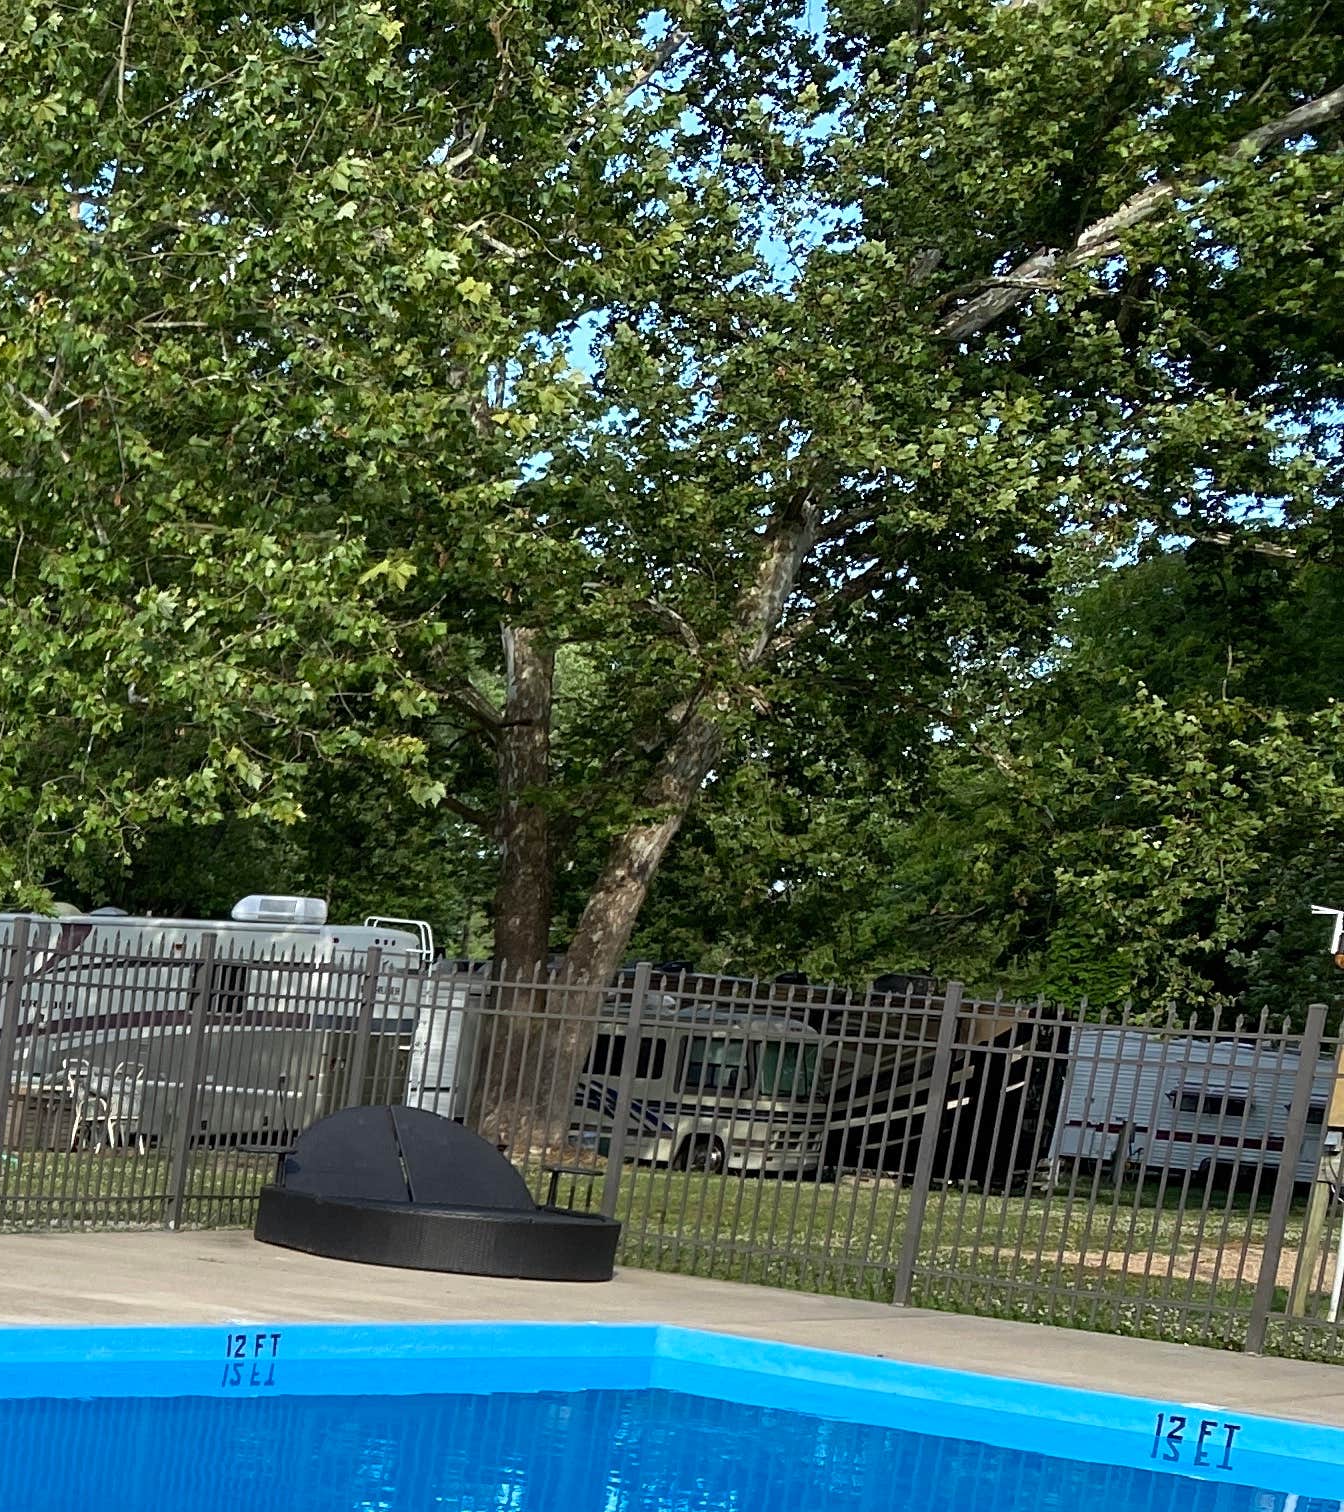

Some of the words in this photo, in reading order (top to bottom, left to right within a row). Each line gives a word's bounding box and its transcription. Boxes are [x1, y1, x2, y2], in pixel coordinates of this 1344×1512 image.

[226, 1333, 247, 1358] 12
[254, 1333, 282, 1358] FT
[1155, 1413, 1186, 1441] 12
[1198, 1419, 1241, 1449] FT
